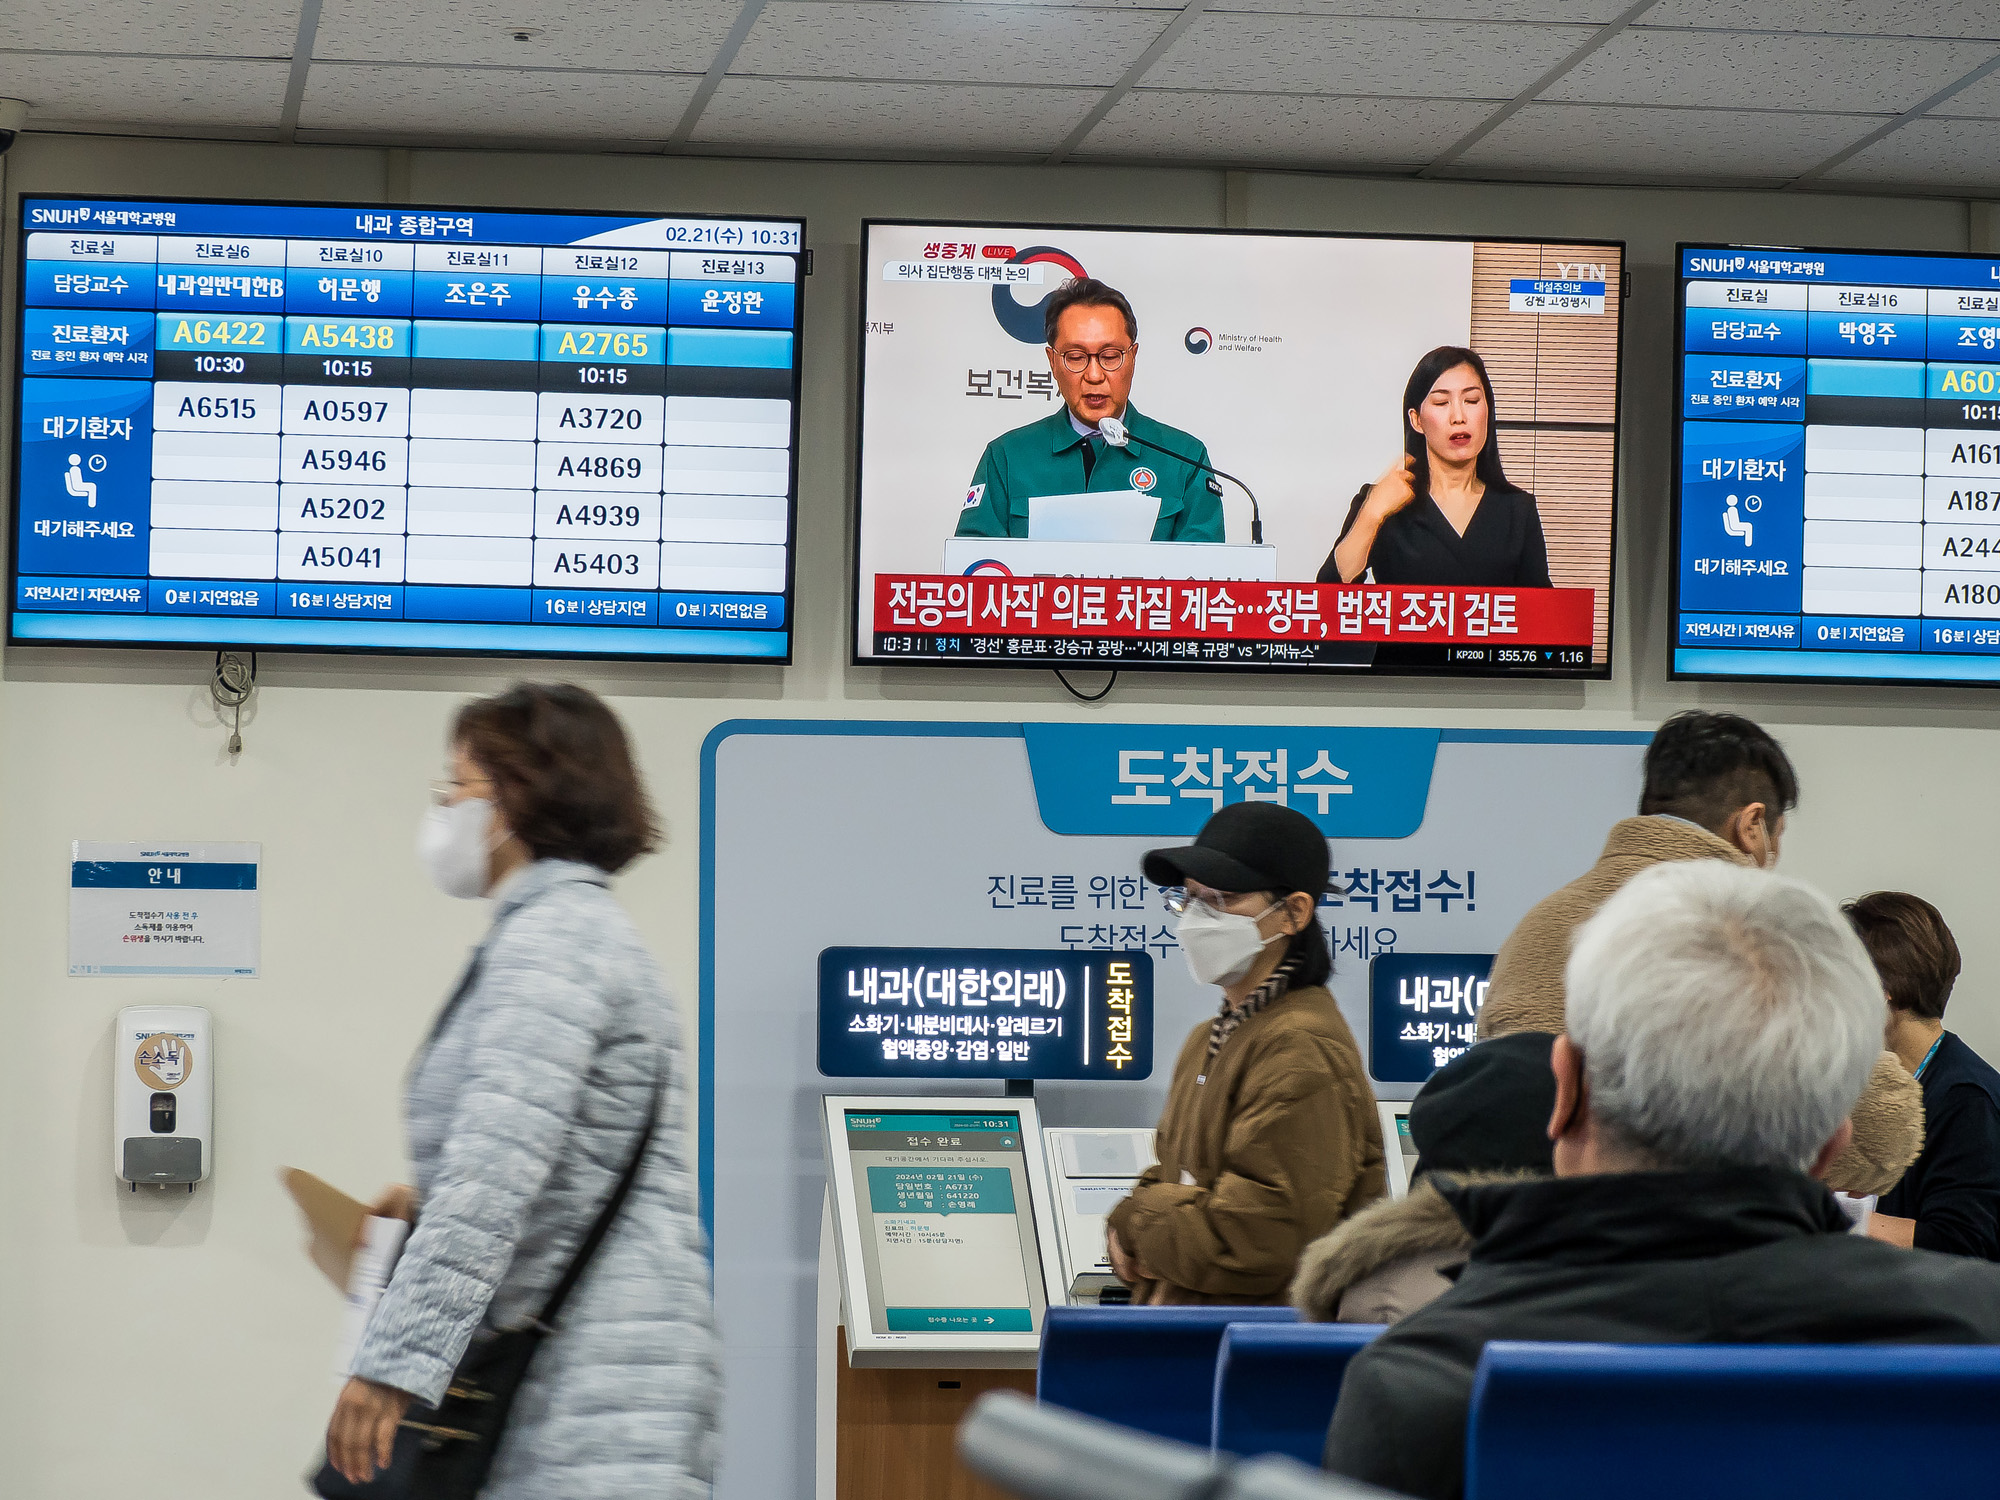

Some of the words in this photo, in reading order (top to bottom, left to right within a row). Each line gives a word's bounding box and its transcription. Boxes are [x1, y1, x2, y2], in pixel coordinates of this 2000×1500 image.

[32, 208, 80, 224] SNUH
[93, 211, 176, 226] 서울대학교병원
[355, 215, 393, 234] 내과
[399, 216, 474, 237] 종합구역
[665, 226, 744, 246] 02.21(수)
[751, 228, 799, 247] 10:31
[70, 240, 115, 255] 진료실
[195, 243, 250, 260] 진료실6
[319, 247, 383, 263] 진료실10
[923, 242, 977, 260] 생중계
[987, 246, 1011, 258] LIVE
[447, 250, 509, 267] 진료실11
[574, 254, 638, 272] 진료실12
[701, 258, 765, 276] 진료실13
[1690, 258, 1734, 273] SNUH
[1747, 260, 1825, 276] 서울대학교병원
[898, 264, 923, 279] 의사
[926, 265, 975, 281] 집단행동
[978, 266, 1003, 281] 대책
[1005, 266, 1030, 282] 논의
[1557, 262, 1606, 280] YTN
[54, 273, 129, 294] 담당교수
[158, 275, 284, 298] 내과일반대한B
[318, 278, 382, 302] 허문행
[1534, 281, 1582, 294] 대설주의보
[444, 283, 511, 306] 조은주
[572, 286, 639, 311] 유수종
[701, 289, 764, 315] 윤정환
[1726, 288, 1768, 304] 진료실
[1838, 291, 1898, 308] 진료실16
[52, 325, 130, 346] 진료환자
[173, 320, 265, 346] A6422
[301, 324, 394, 350] A5438
[1218, 332, 1247, 344] Ministry
[1248, 333, 1256, 342] of
[1258, 334, 1283, 344] Health
[1711, 321, 1782, 342] 담당교수
[1838, 322, 1897, 346] 박영주
[558, 332, 648, 357] A2765
[1218, 342, 1233, 352] and
[1234, 343, 1262, 353] Welfare
[31, 349, 52, 361] 진료
[55, 350, 75, 362] 중인
[79, 350, 100, 363] 환자
[103, 351, 125, 363] 예약
[127, 352, 149, 364] 시각
[194, 356, 245, 373] 10:30
[322, 359, 373, 376] 10:15
[578, 368, 627, 384] 10:15
[965, 368, 1061, 402] 보건복
[1710, 370, 1782, 391] 진료환자
[178, 397, 256, 419] A6515
[1690, 393, 1710, 405] 진료
[1712, 394, 1733, 406] 중인
[1735, 395, 1755, 407] 환자
[1758, 396, 1778, 408] 예약
[1780, 396, 1800, 409] 시각
[303, 401, 389, 423] A0597
[559, 408, 642, 430] A3720
[43, 416, 133, 441] 대기환자
[302, 449, 386, 472] A5946
[557, 456, 642, 478] A4869
[1702, 458, 1786, 482] 대기환자
[301, 498, 385, 520] A5202
[556, 505, 640, 527] A4939
[34, 520, 135, 539] 대기해주세요
[301, 546, 381, 568] A5041
[554, 553, 639, 575] A5403
[1694, 558, 1789, 577] 대기해주세요
[24, 585, 79, 601] 지연시간
[87, 587, 141, 603] 지연사유
[165, 589, 190, 605] 0분
[199, 591, 260, 607] 지연없음
[289, 592, 323, 608] 16분
[332, 593, 392, 610] 상담지연
[545, 599, 578, 615] 16분
[587, 600, 647, 617] 상담지연
[675, 603, 700, 618] 0분
[709, 604, 768, 620] 지연없음
[888, 582, 974, 627] 전공의
[980, 581, 1046, 629] 사직'
[1052, 584, 1109, 630] 의료
[1115, 585, 1173, 631] 차질
[1336, 591, 1392, 636] 법적
[1398, 592, 1456, 637] 조치
[1464, 593, 1519, 637] 검토
[1685, 623, 1736, 637] 지연시간
[1744, 625, 1795, 639] 지연사유
[1817, 626, 1841, 641] 0분
[1849, 627, 1905, 642] 지연없음
[1933, 628, 1965, 644] 16분
[884, 636, 921, 652] 10:31
[970, 638, 1004, 654] '경선'
[1172, 642, 1199, 658] 의혹
[1202, 642, 1234, 658] 규명"
[1237, 645, 1253, 657] vs
[1256, 644, 1320, 660] "가짜뉴스"
[1456, 650, 1484, 660] KP200
[1498, 649, 1537, 663] 355.76
[1559, 651, 1584, 664] 1.16
[1111, 747, 1353, 815] 도착접수
[987, 875, 1079, 911] 진료를
[1088, 875, 1149, 911] 위한
[129, 911, 164, 920] 도착접수기
[848, 965, 1066, 1010] 내과(대한외래)
[1106, 962, 1134, 1070] 도착접수
[138, 1050, 180, 1066] 손소독
[983, 1120, 1009, 1128] 10:31
[906, 1136, 932, 1147] 접수
[937, 1137, 962, 1147] 완료
[945, 1183, 974, 1191] A6737
[968, 1174, 983, 1182] (수)
[946, 1192, 980, 1200] 641220
